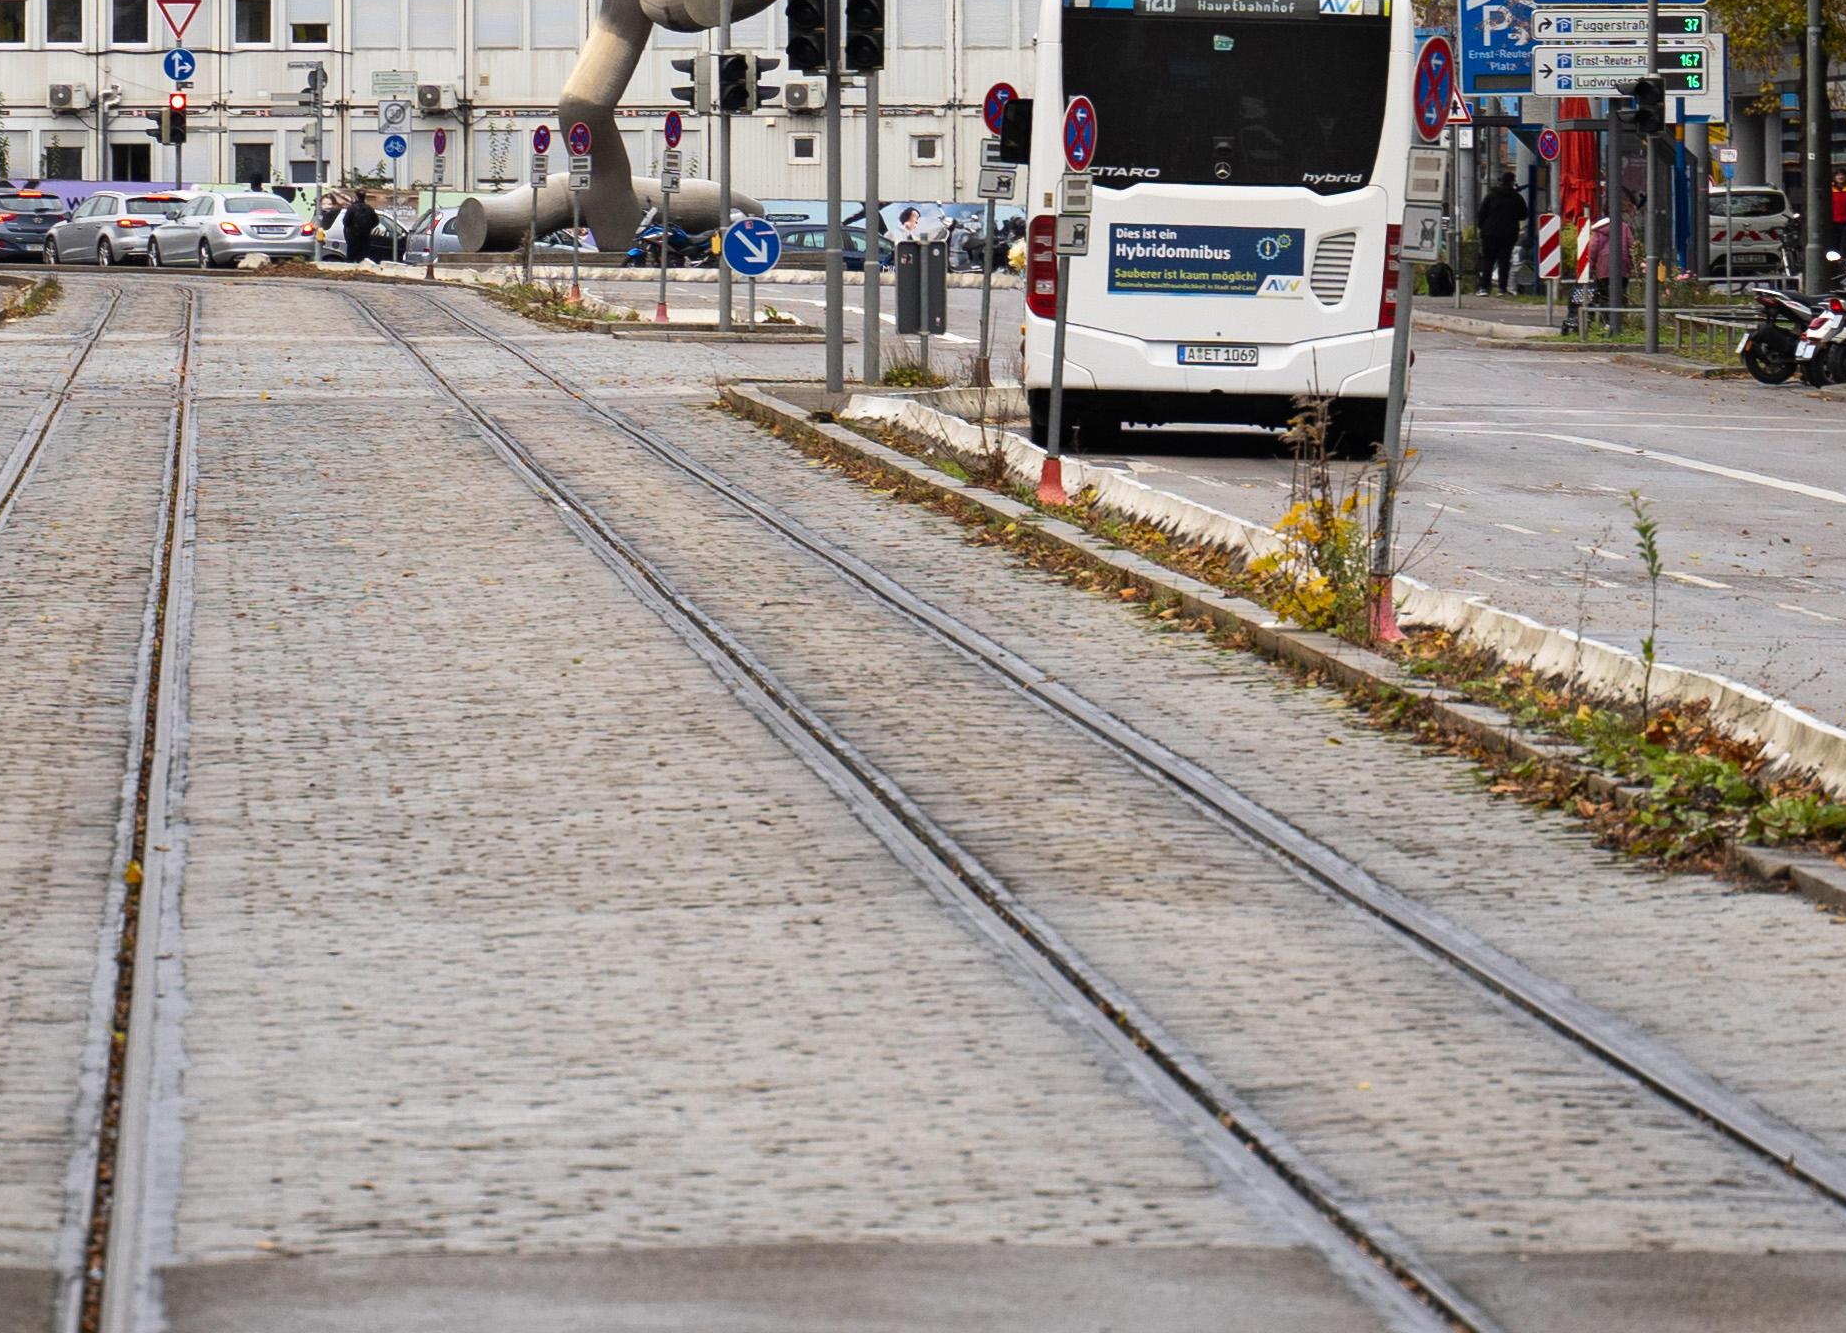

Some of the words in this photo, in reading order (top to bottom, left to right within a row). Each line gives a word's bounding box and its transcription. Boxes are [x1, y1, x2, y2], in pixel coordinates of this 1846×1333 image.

[1197, 0, 1296, 14] Hauptbahnhof
[1684, 19, 1699, 31] 37
[1679, 54, 1699, 66] 167
[1490, 62, 1516, 71] Platz
[1686, 75, 1700, 87] 16
[1303, 172, 1362, 183] hybrid
[1116, 228, 1140, 239] Dies
[1142, 228, 1156, 239] ist
[1158, 229, 1177, 240] ein
[1116, 243, 1231, 261] Hybridomnibus
[1115, 268, 1162, 279] Sauberer
[1164, 269, 1177, 279] ist
[1179, 269, 1209, 280] kaum
[1211, 270, 1257, 282] möglich!
[1266, 278, 1300, 291] AVV
[1188, 349, 1196, 361] A
[1205, 349, 1221, 361] ET
[1224, 349, 1257, 362] 1069
